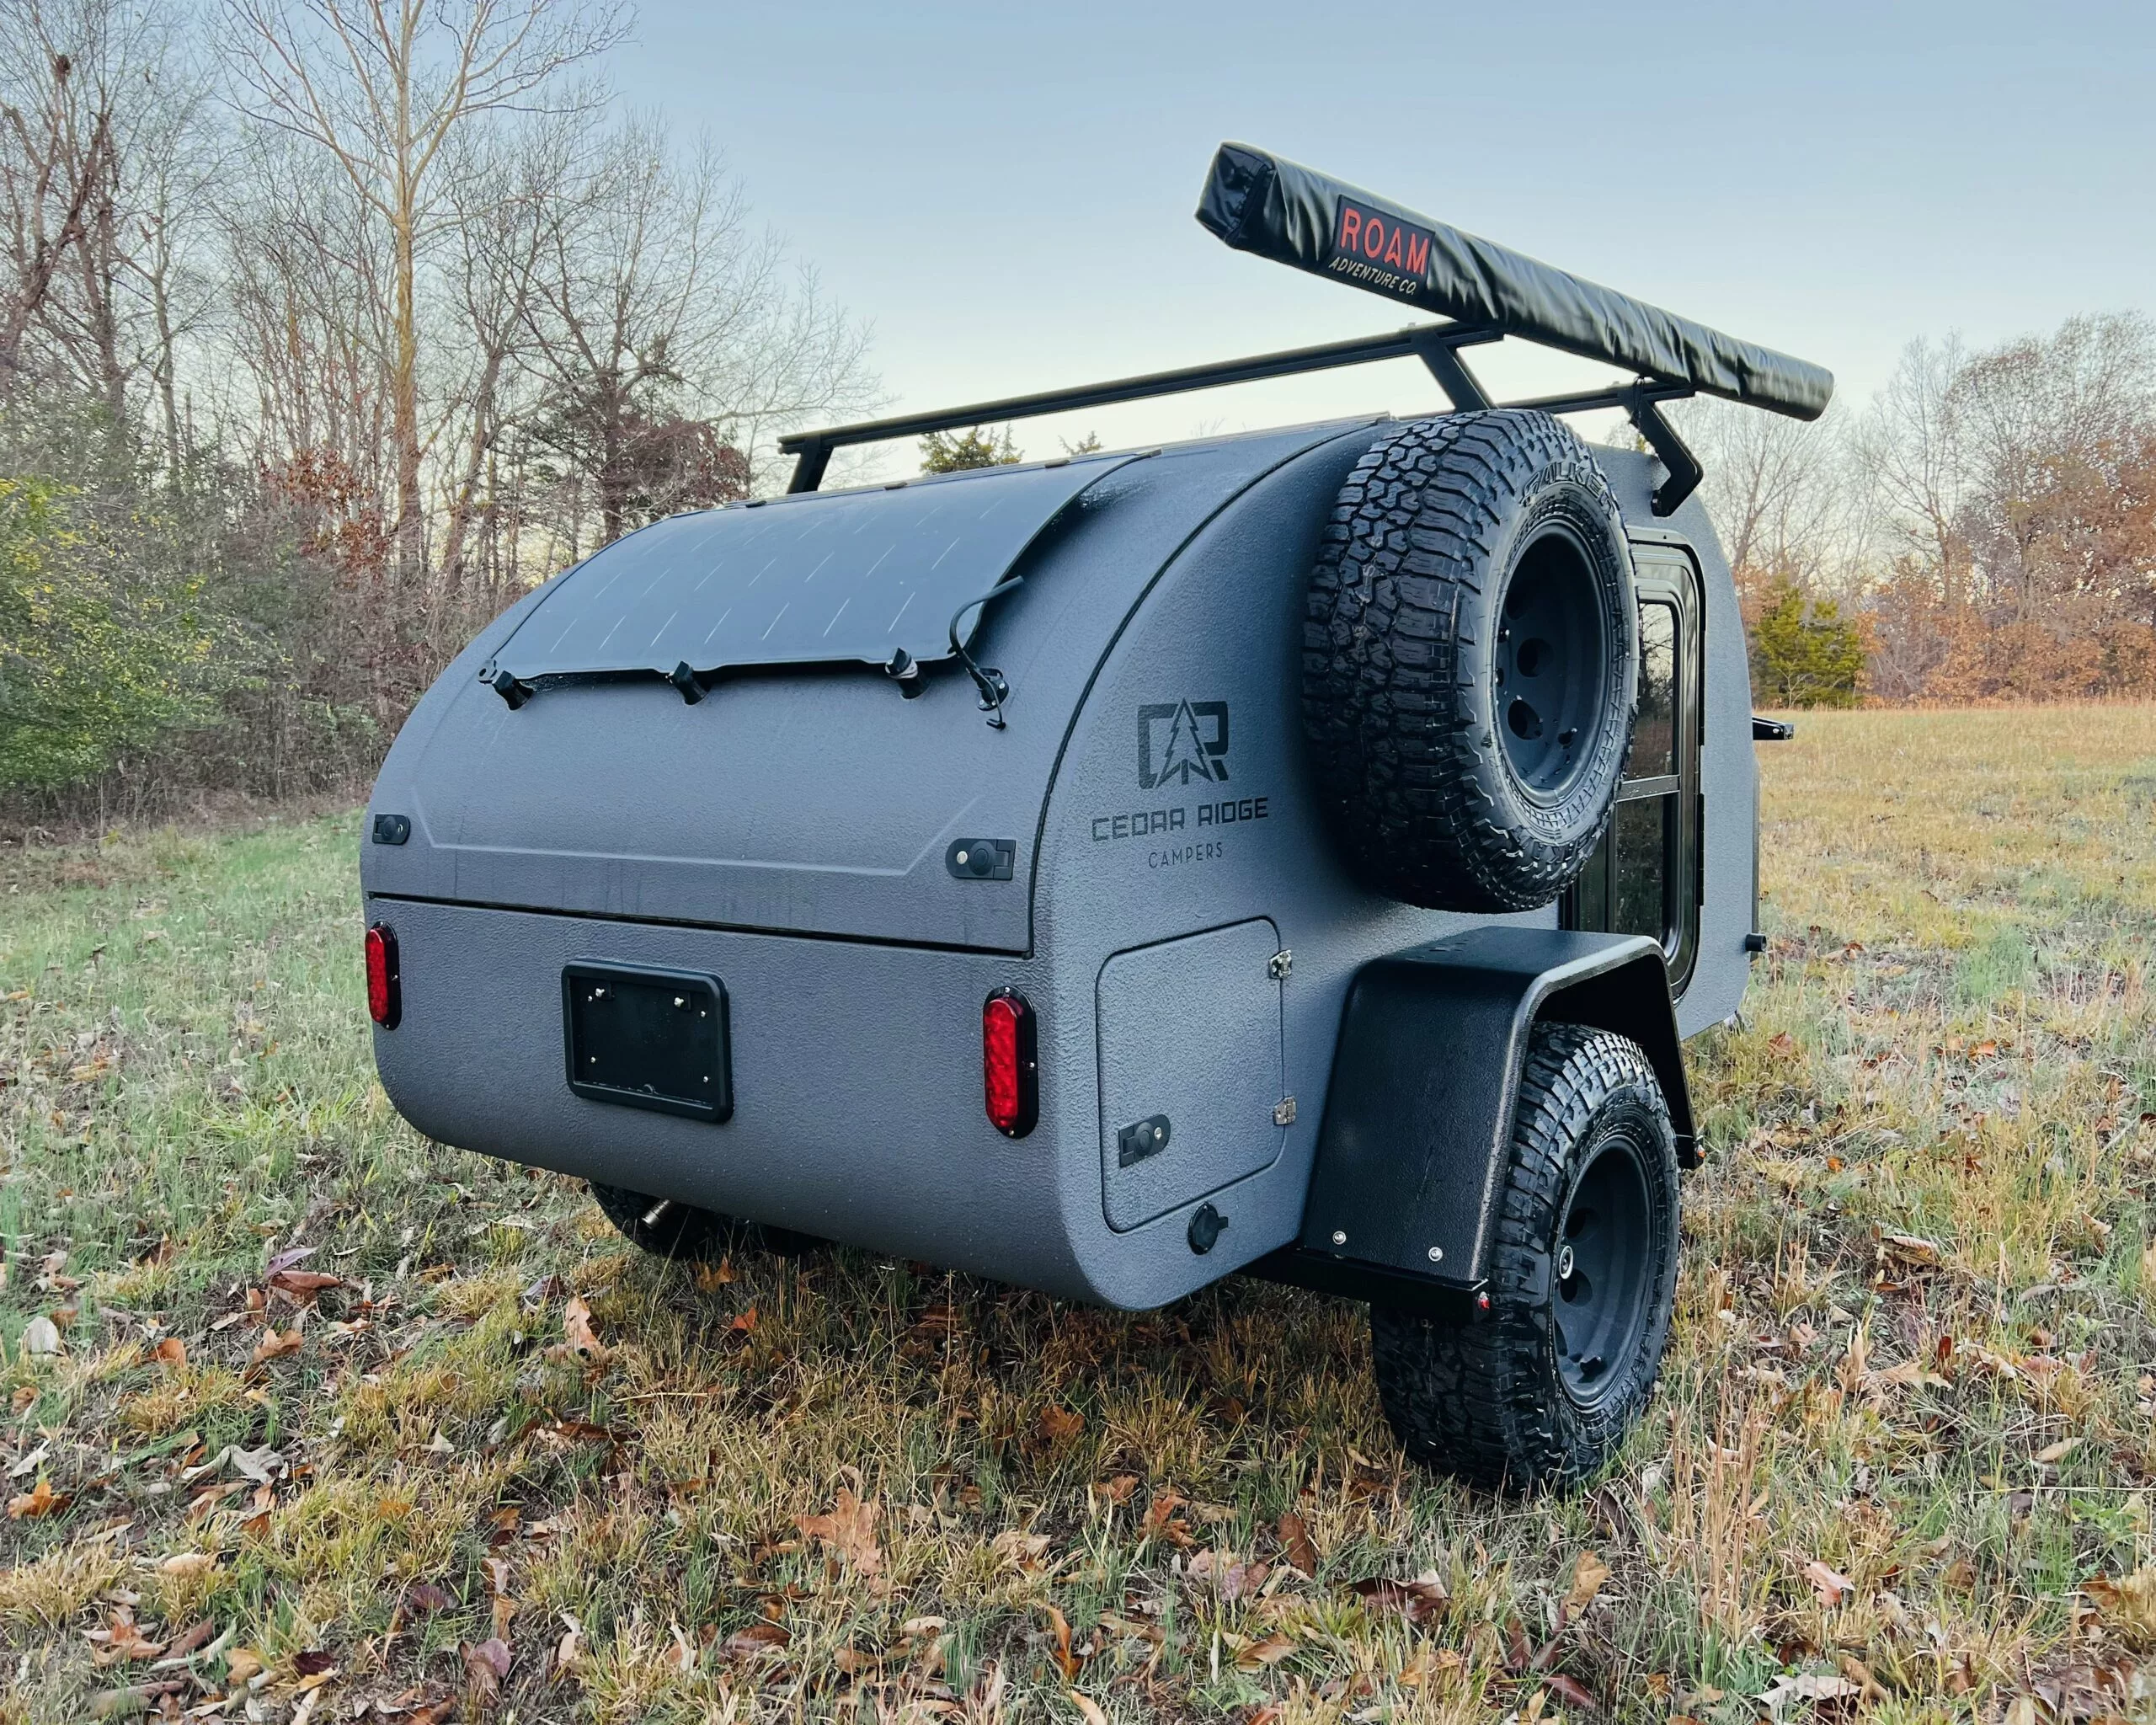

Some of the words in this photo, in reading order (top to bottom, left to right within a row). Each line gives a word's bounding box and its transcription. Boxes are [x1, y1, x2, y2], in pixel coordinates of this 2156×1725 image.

[1341, 207, 1429, 275] ROAM
[1328, 256, 1400, 289] ADVENTURE
[1399, 280, 1417, 296] CO.
[1092, 807, 1185, 842] CEDAR
[1198, 798, 1268, 827] RIDGE
[1148, 842, 1222, 869] CAMPERS
